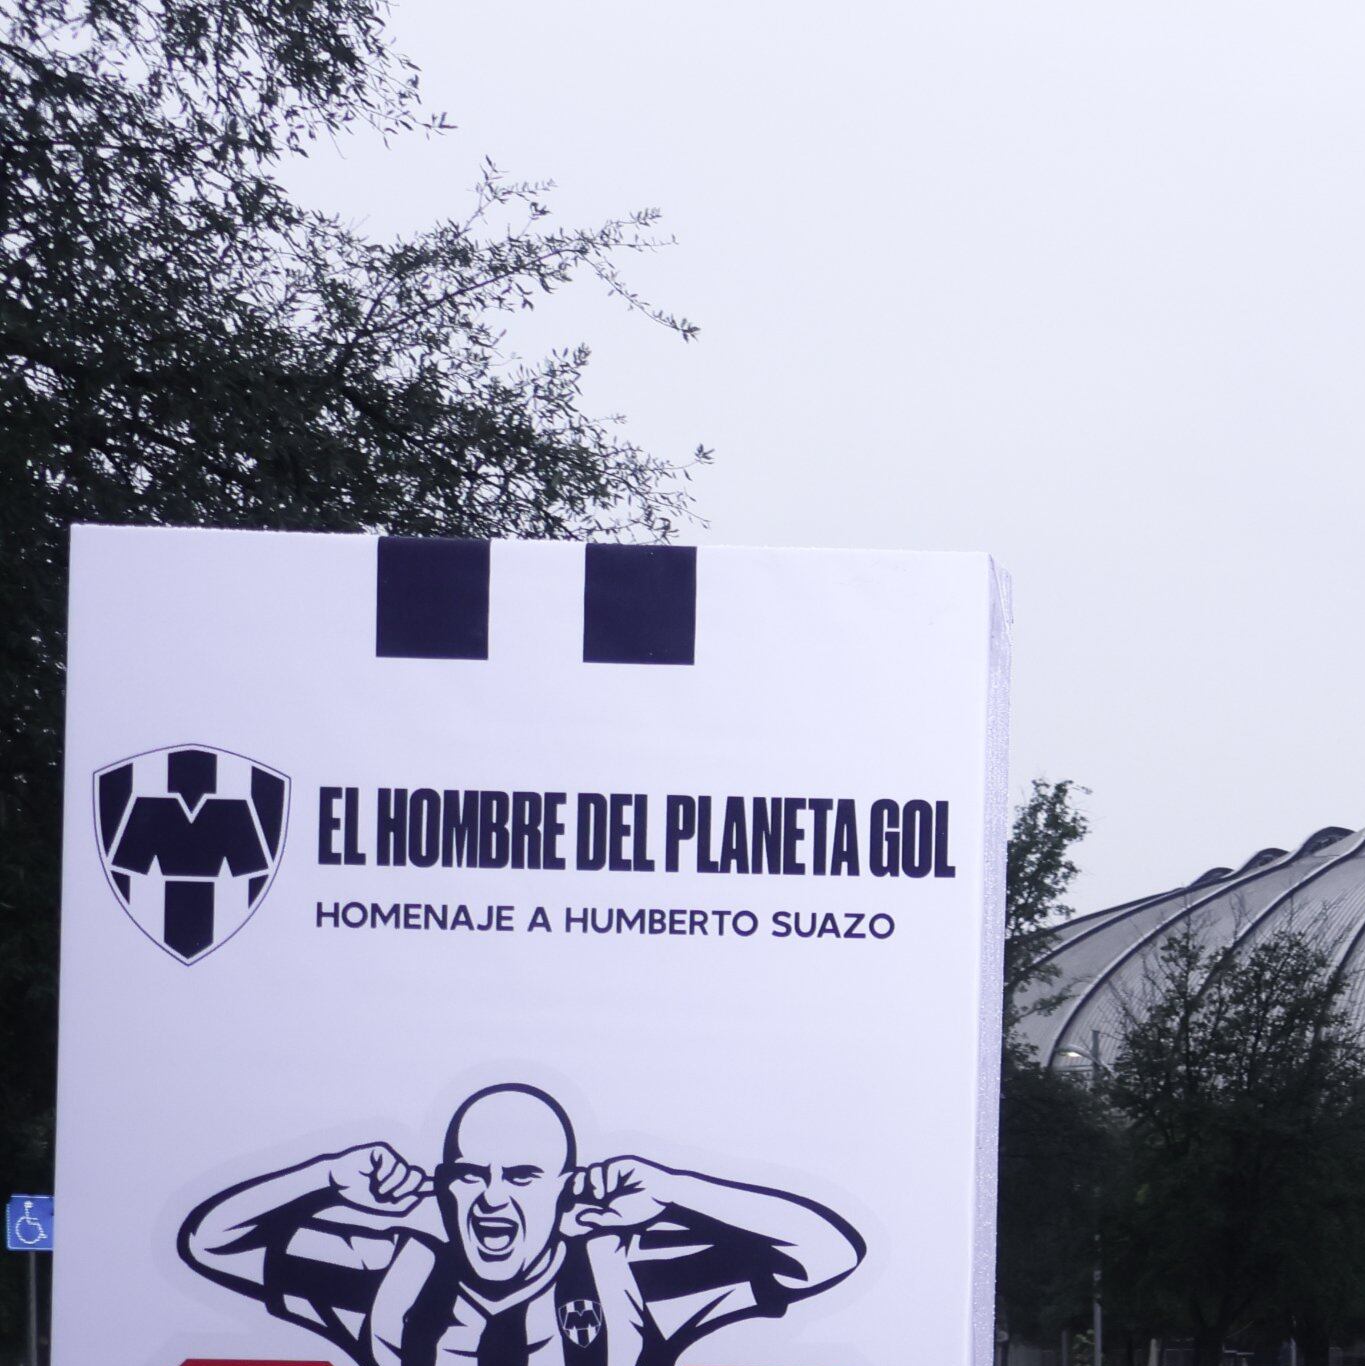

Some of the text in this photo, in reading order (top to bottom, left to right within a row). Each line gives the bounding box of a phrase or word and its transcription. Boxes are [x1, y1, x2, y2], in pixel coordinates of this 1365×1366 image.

[317, 786, 956, 879] EL HOMBRE DEL PLANETA GOL
[316, 901, 896, 940] HOMENAJE A HUMBERTO SUAZO
